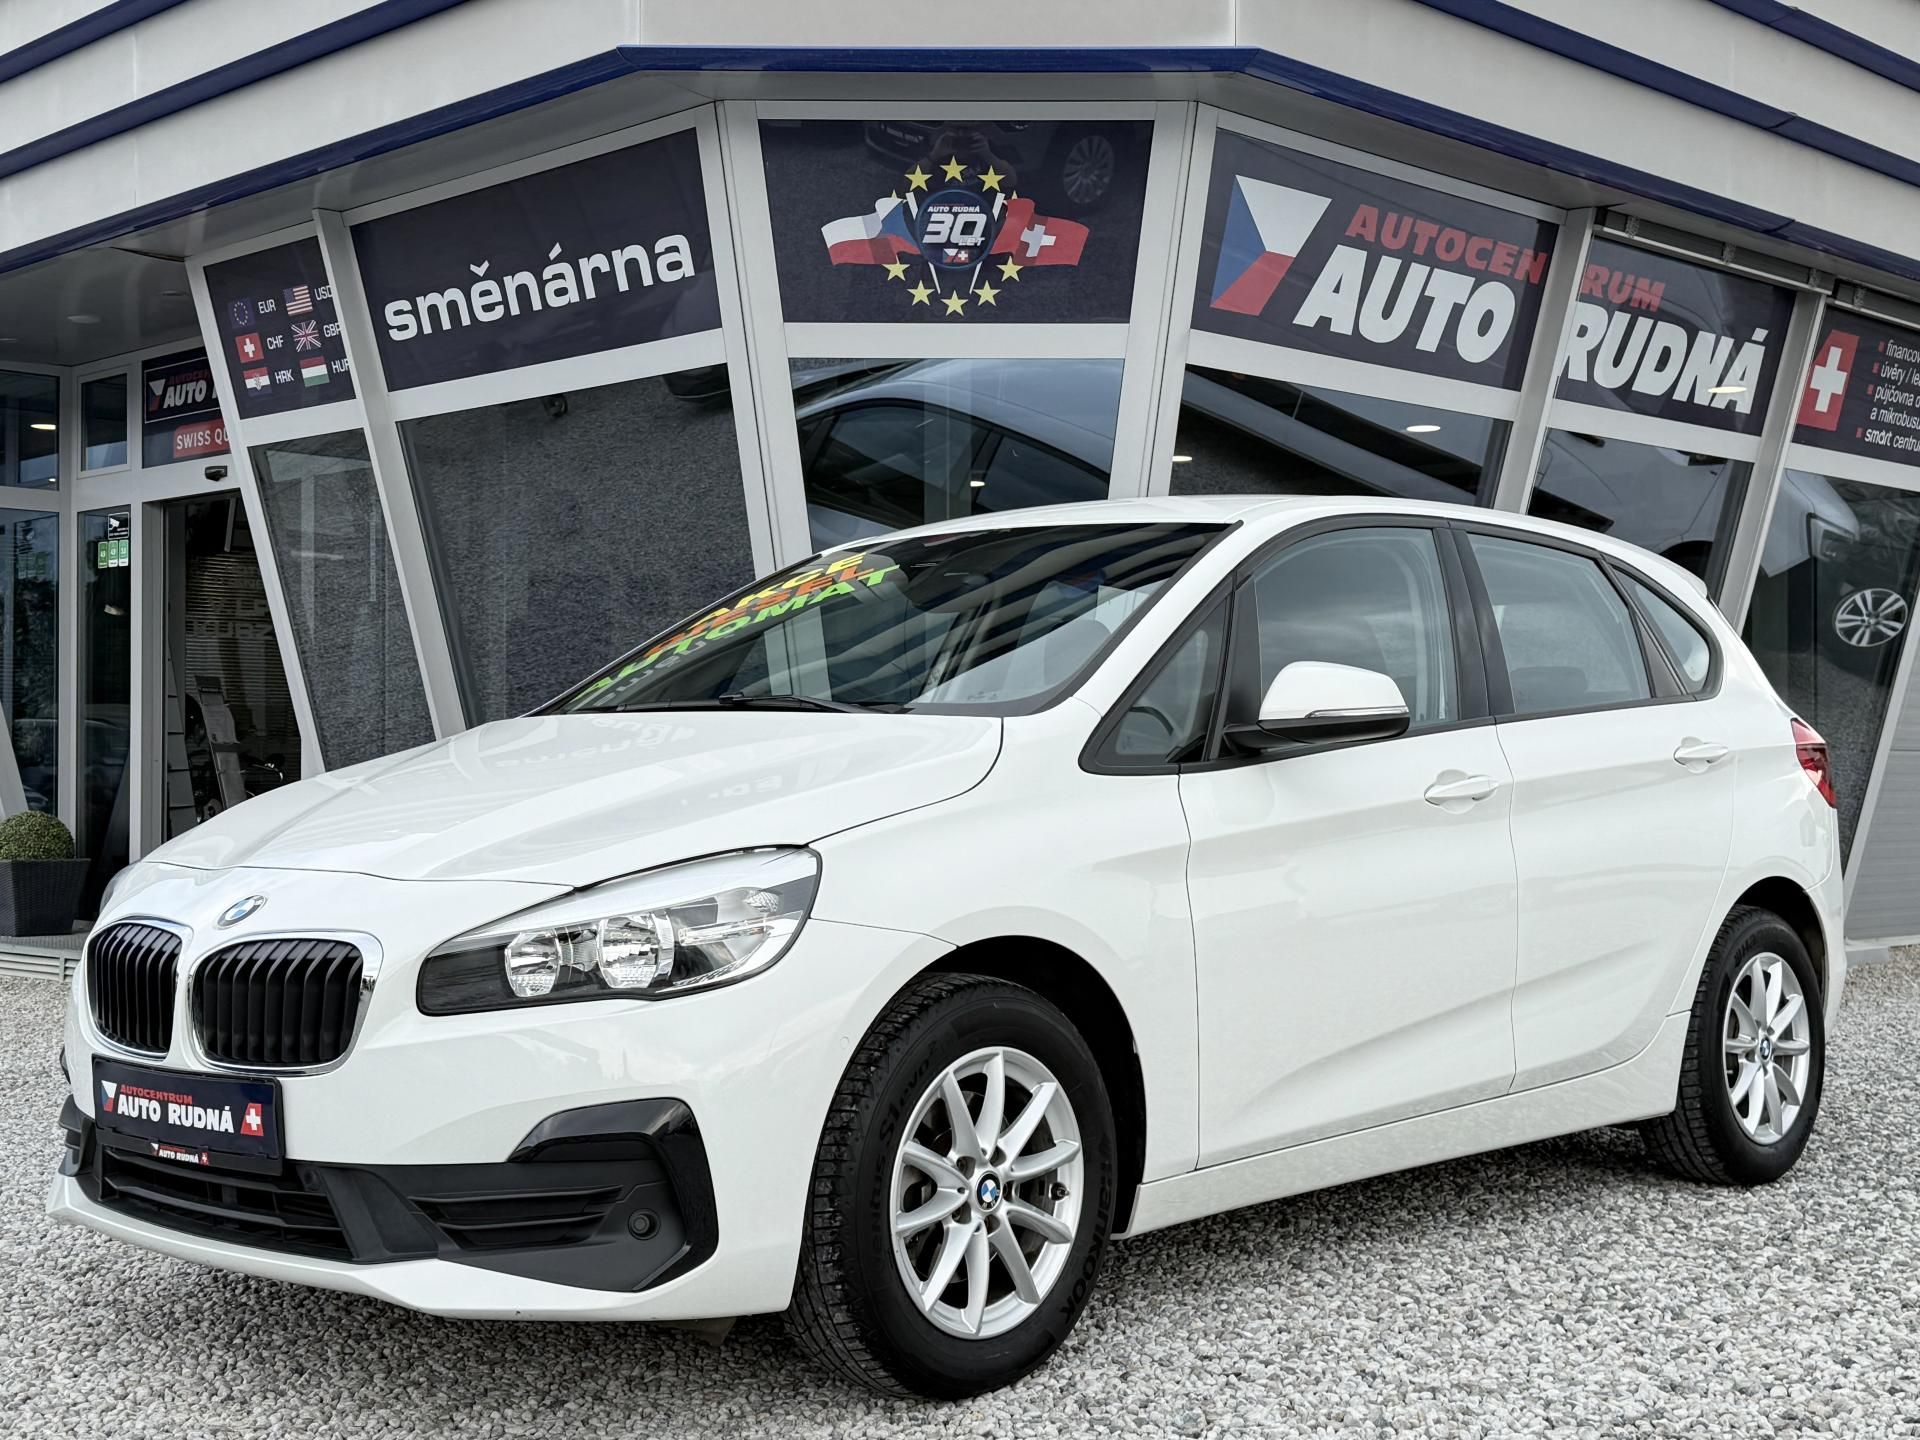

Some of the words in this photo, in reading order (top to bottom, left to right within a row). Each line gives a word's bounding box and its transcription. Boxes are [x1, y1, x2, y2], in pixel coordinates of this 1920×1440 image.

[922, 213, 987, 243] 30
[958, 237, 985, 246] LET
[384, 234, 695, 341] směnárna
[258, 299, 276, 313] EUR
[1292, 244, 1516, 363] AUTO
[1560, 301, 1769, 414] RUDNÁ
[267, 335, 284, 349] CHF
[274, 369, 294, 384] HRK
[1911, 368, 1920, 387] le
[163, 380, 207, 408] AUTO
[1870, 407, 1877, 420] a
[176, 430, 211, 450] SWISS
[1893, 435, 1920, 452] centru
[687, 552, 866, 630] AKCE
[571, 564, 900, 703] AUTOMAT
[120, 1084, 193, 1104] AUTOCENTRUM
[118, 1094, 161, 1122] AUTO
[168, 1103, 234, 1134] RUDNÁ
[159, 1149, 175, 1159] AUTO
[176, 1152, 199, 1163] RUDNÁ
